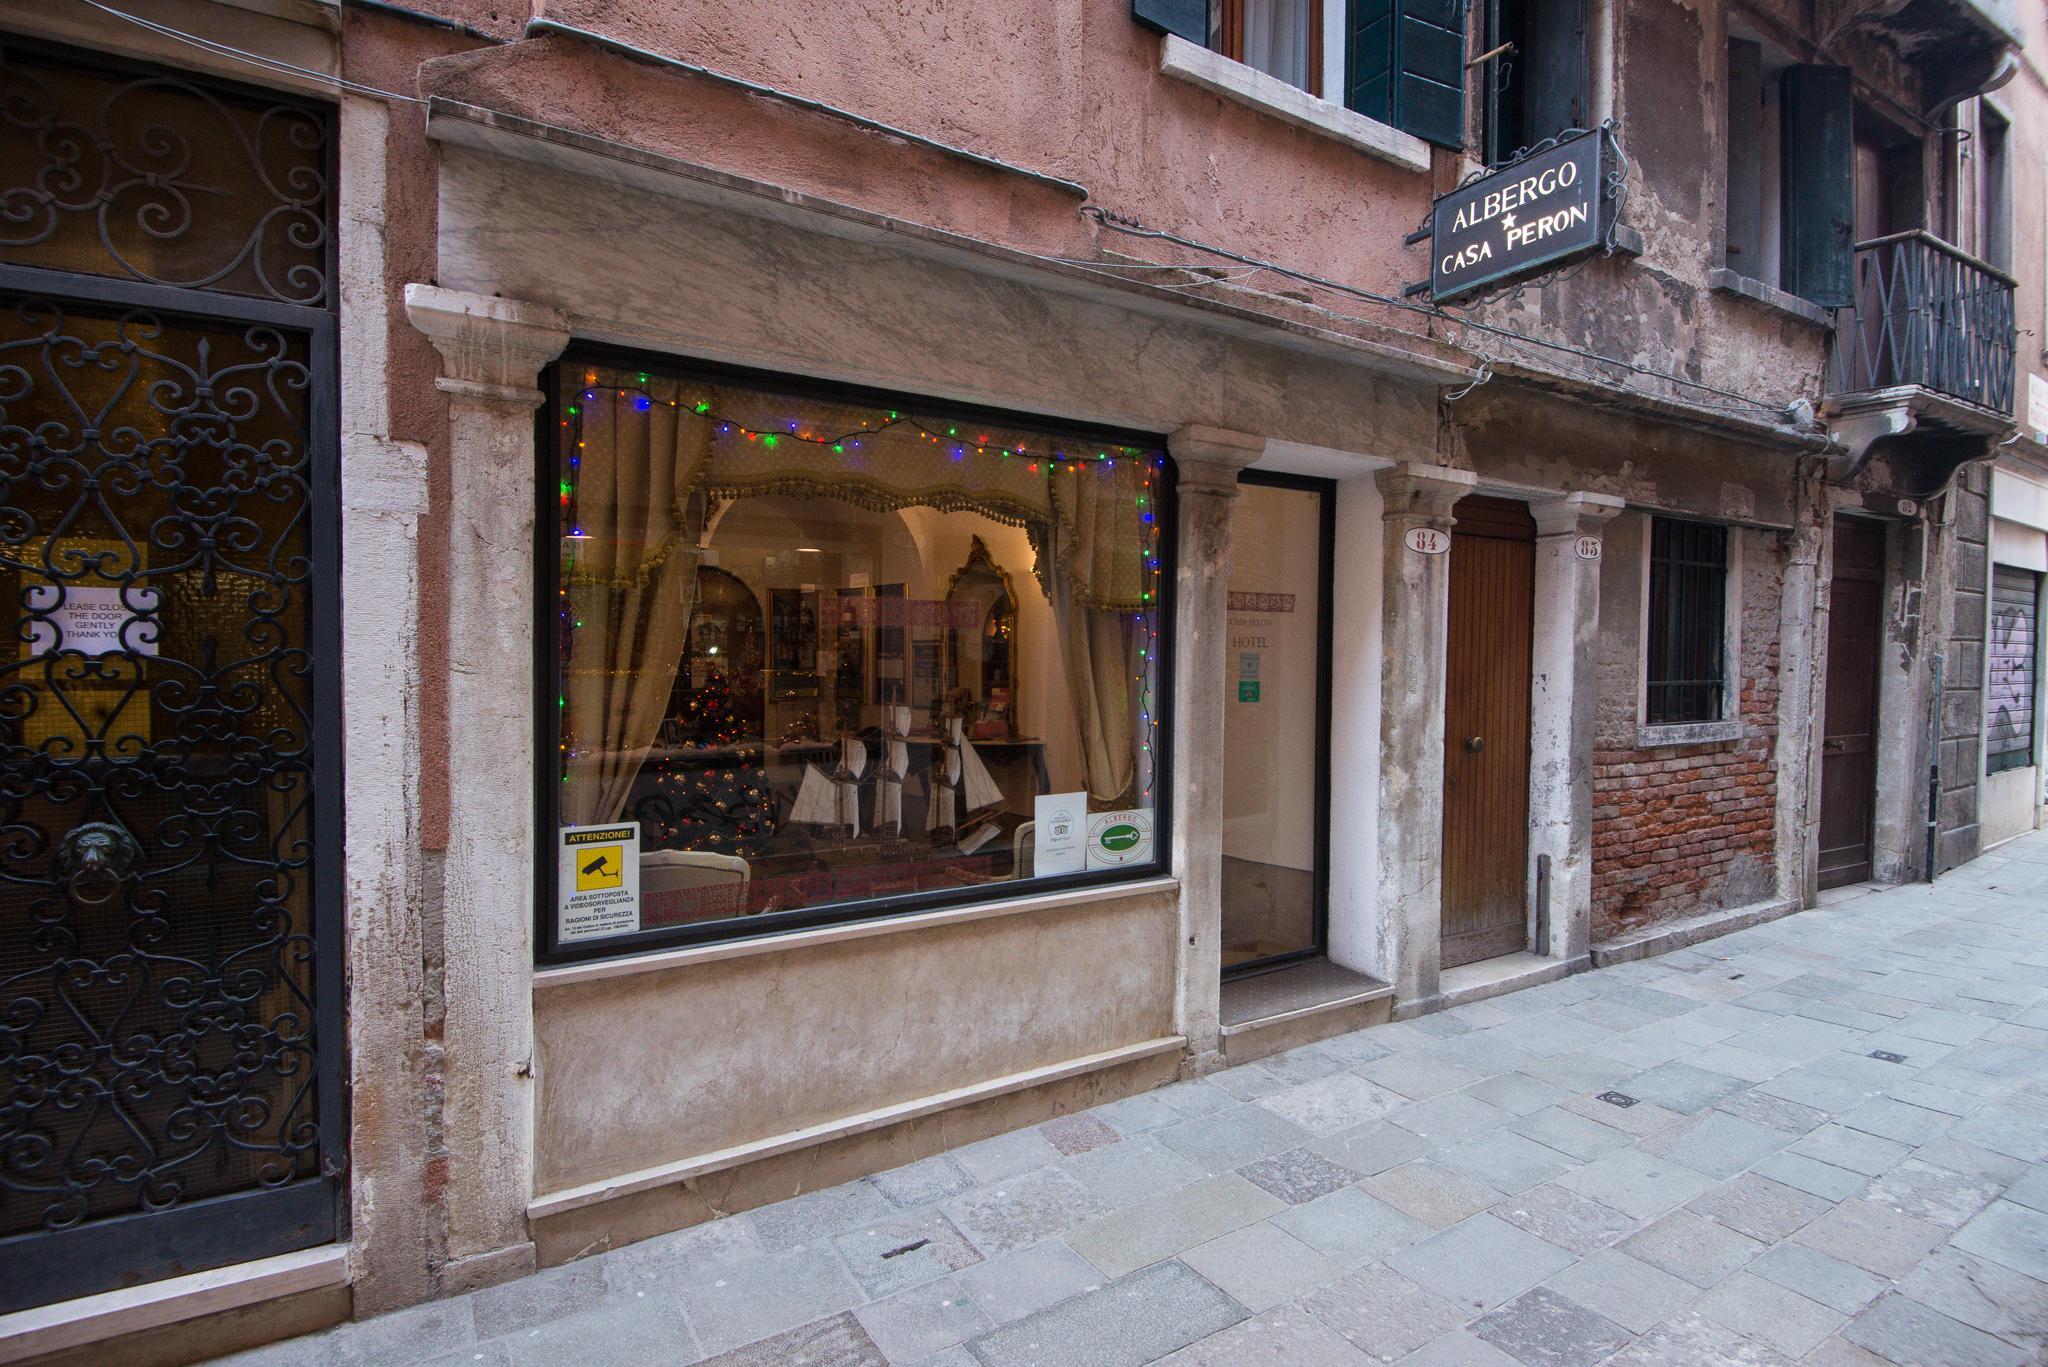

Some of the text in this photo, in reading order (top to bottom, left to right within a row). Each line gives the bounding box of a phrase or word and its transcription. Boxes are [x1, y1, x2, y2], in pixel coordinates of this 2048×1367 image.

[1452, 160, 1577, 233] ALBERGO
[1441, 202, 1587, 275] CASA PERON
[1416, 531, 1437, 551] 84
[63, 603, 127, 611] LEASE CLOS
[68, 612, 122, 620] THE DOOR
[75, 621, 116, 630] GENTLY
[66, 630, 118, 639] THANK YO
[1232, 636, 1269, 648] HOTEL
[1105, 815, 1137, 824] ALBERGO
[569, 831, 631, 843] ATTENZIONE!
[570, 890, 629, 902] AREA SOTTOPOSTA
[570, 896, 635, 909] VIDEOSORVEGLIANZA
[565, 915, 592, 924] RAGIONI
[600, 910, 633, 920] SICUREZZA
